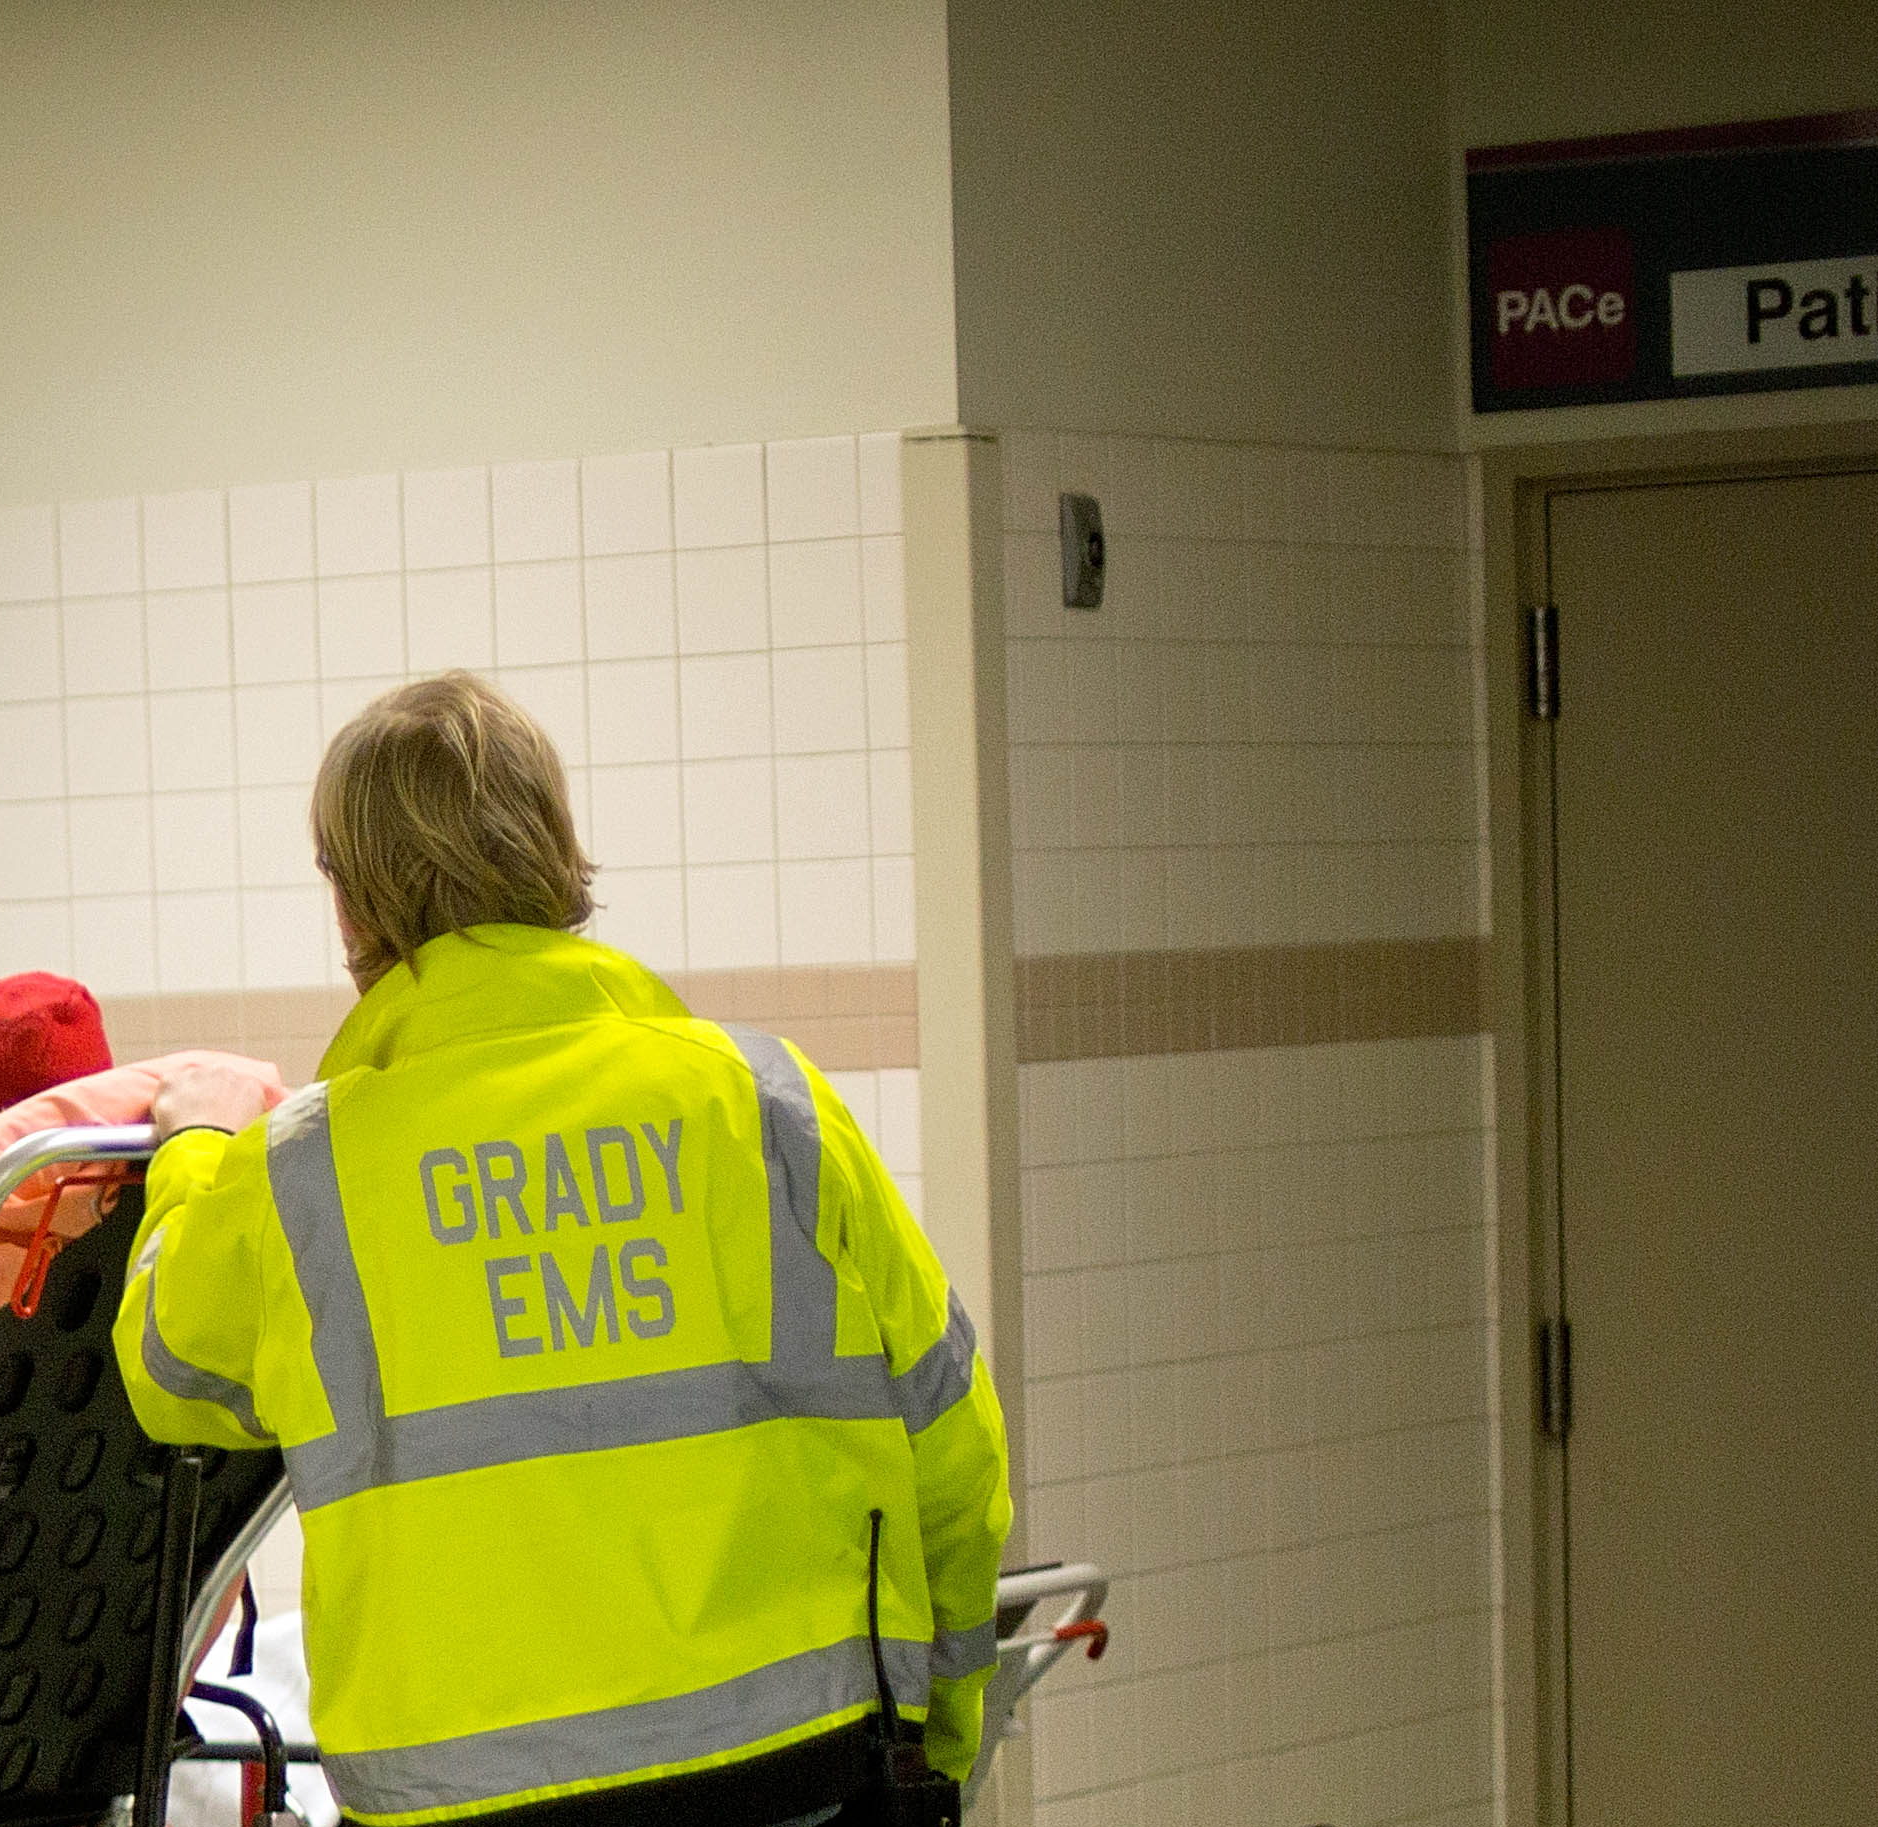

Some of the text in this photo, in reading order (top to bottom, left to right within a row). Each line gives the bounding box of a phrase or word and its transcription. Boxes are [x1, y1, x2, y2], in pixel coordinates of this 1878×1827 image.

[1496, 284, 1627, 336] PACe
[418, 1118, 685, 1247] GRADY
[484, 1237, 677, 1359] EMS
